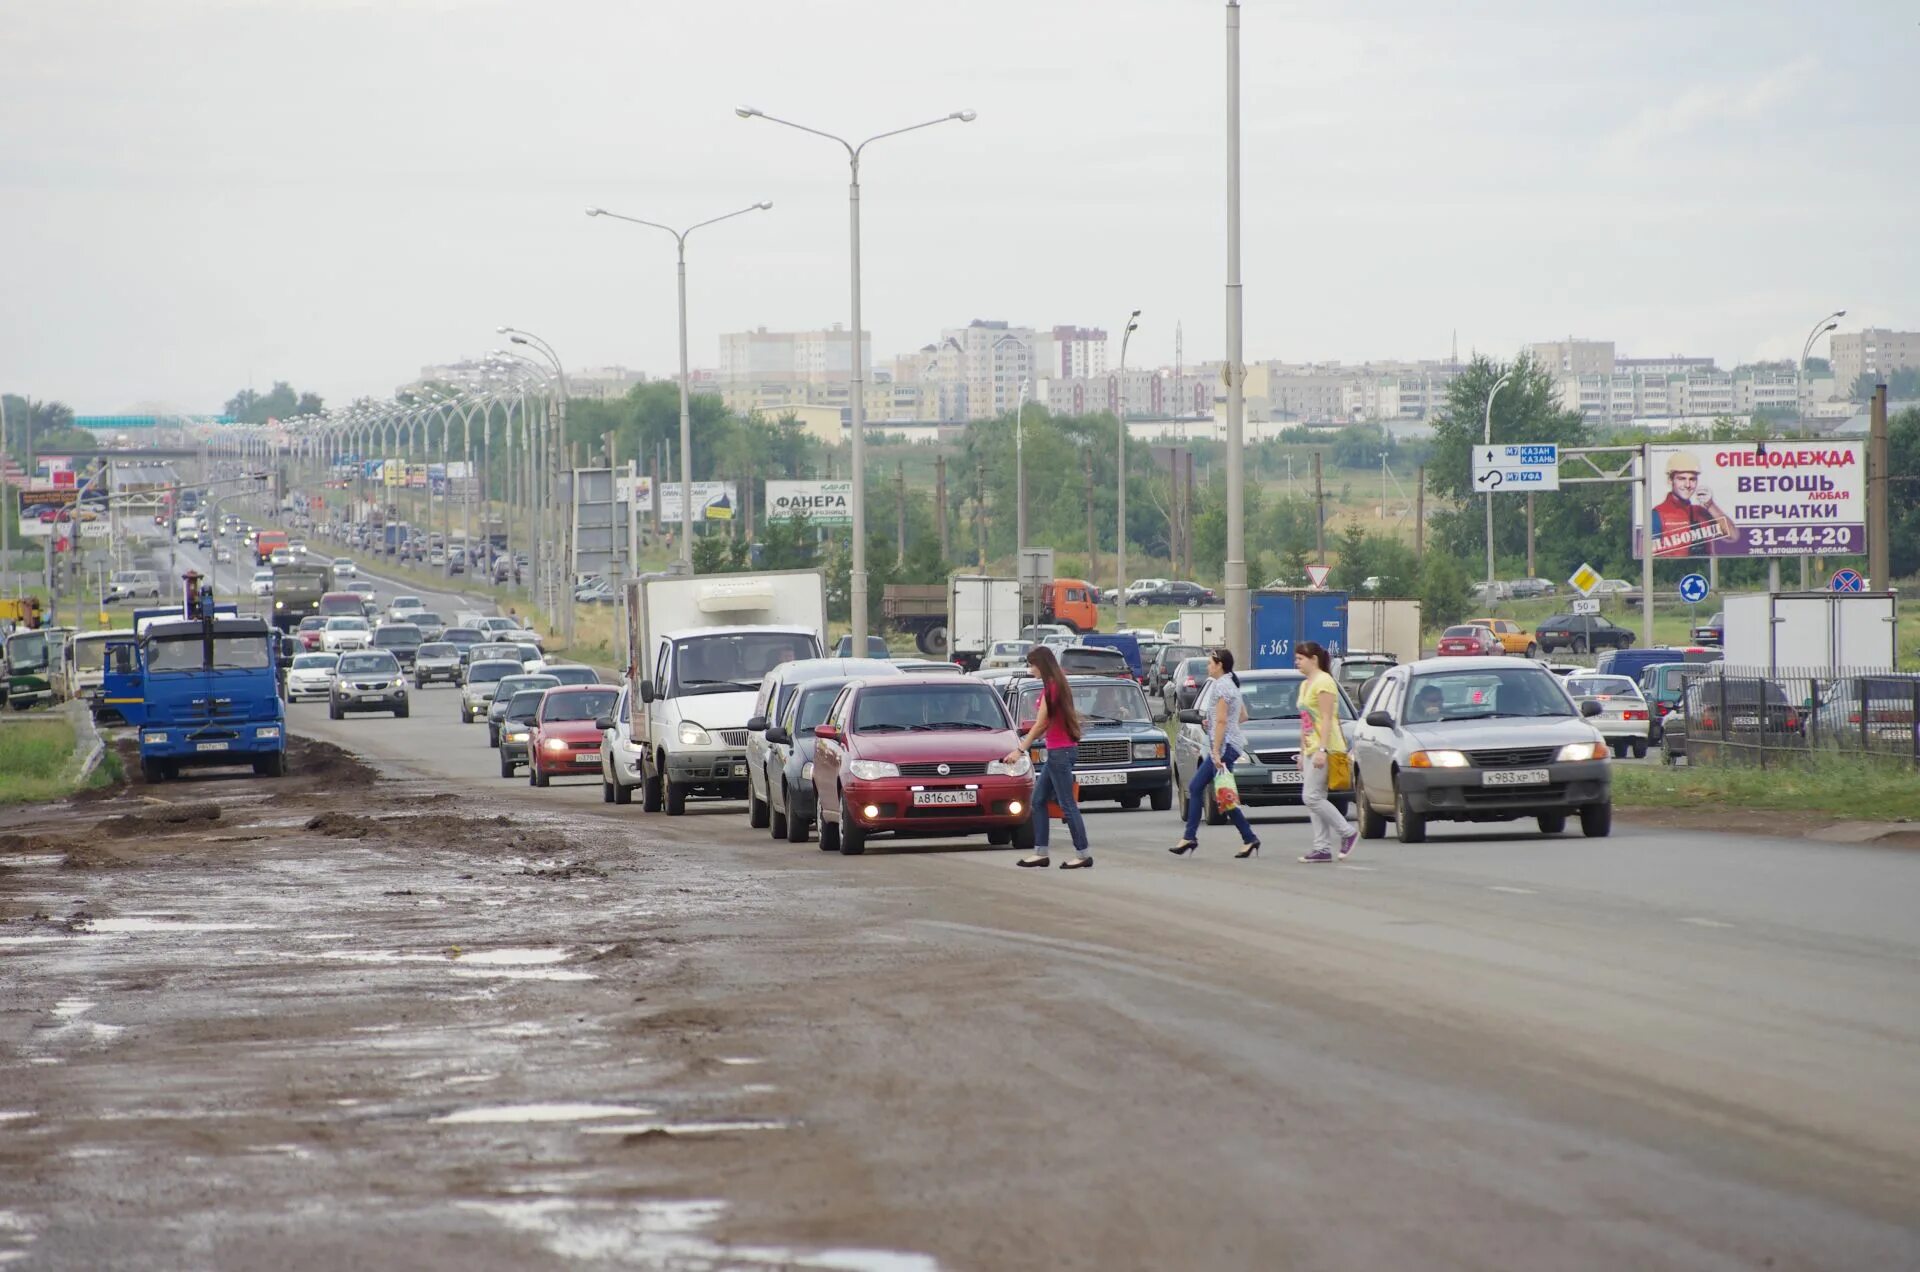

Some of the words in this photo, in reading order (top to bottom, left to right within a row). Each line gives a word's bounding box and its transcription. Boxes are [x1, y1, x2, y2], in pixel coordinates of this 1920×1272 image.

[1506, 447, 1518, 455] М7
[1521, 447, 1550, 455] КАЗАН
[1521, 455, 1555, 463] КАЗАНЬ
[1715, 450, 1855, 468] СПЕЦОДЕЖДА
[1738, 475, 1834, 492] ВЕТОШЬ
[776, 495, 847, 508] ФАНЕРА
[1808, 491, 1850, 500] ЛЮБАЯ
[1735, 503, 1837, 519] ПЕРЧАТКИ
[1652, 523, 1724, 552] ЛАБОМИД
[1750, 527, 1851, 546] 31-44-20
[1577, 602, 1589, 611] 50
[1269, 640, 1289, 655] 365
[1530, 771, 1548, 779] 116
[918, 793, 957, 803] А816СА
[960, 791, 975, 801] 116
